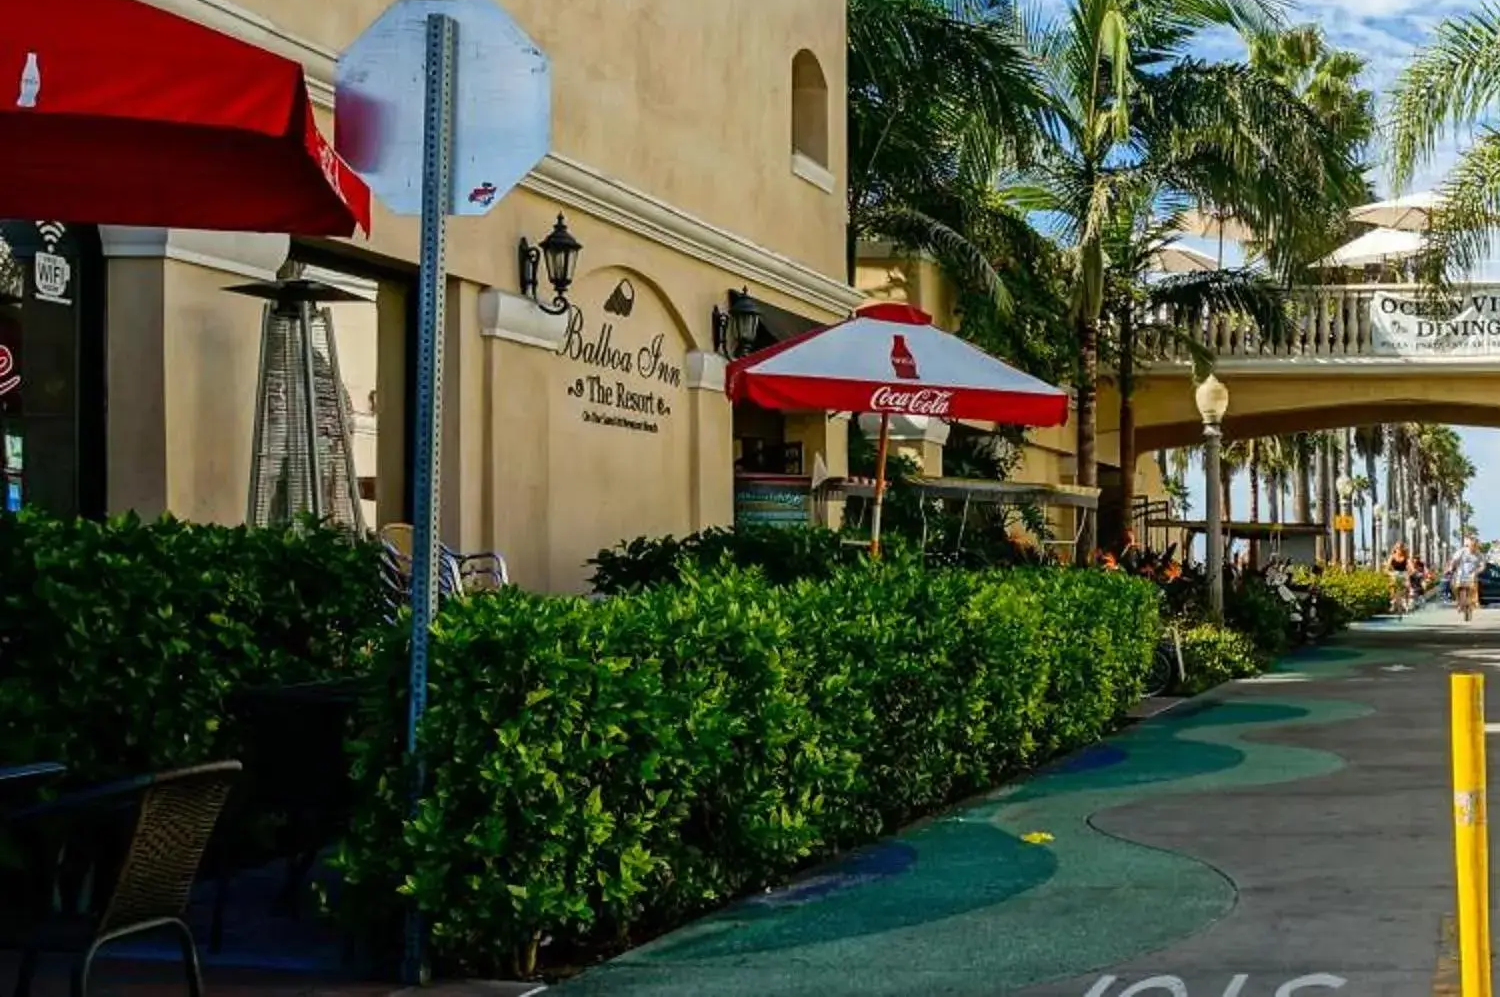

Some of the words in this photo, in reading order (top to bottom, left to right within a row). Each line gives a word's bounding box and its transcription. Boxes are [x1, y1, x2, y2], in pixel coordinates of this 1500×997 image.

[556, 304, 632, 373] Balboa
[637, 333, 681, 388] Inn
[585, 375, 613, 407] The
[616, 382, 655, 415] Resort
[870, 386, 954, 414] Coca-Cola
